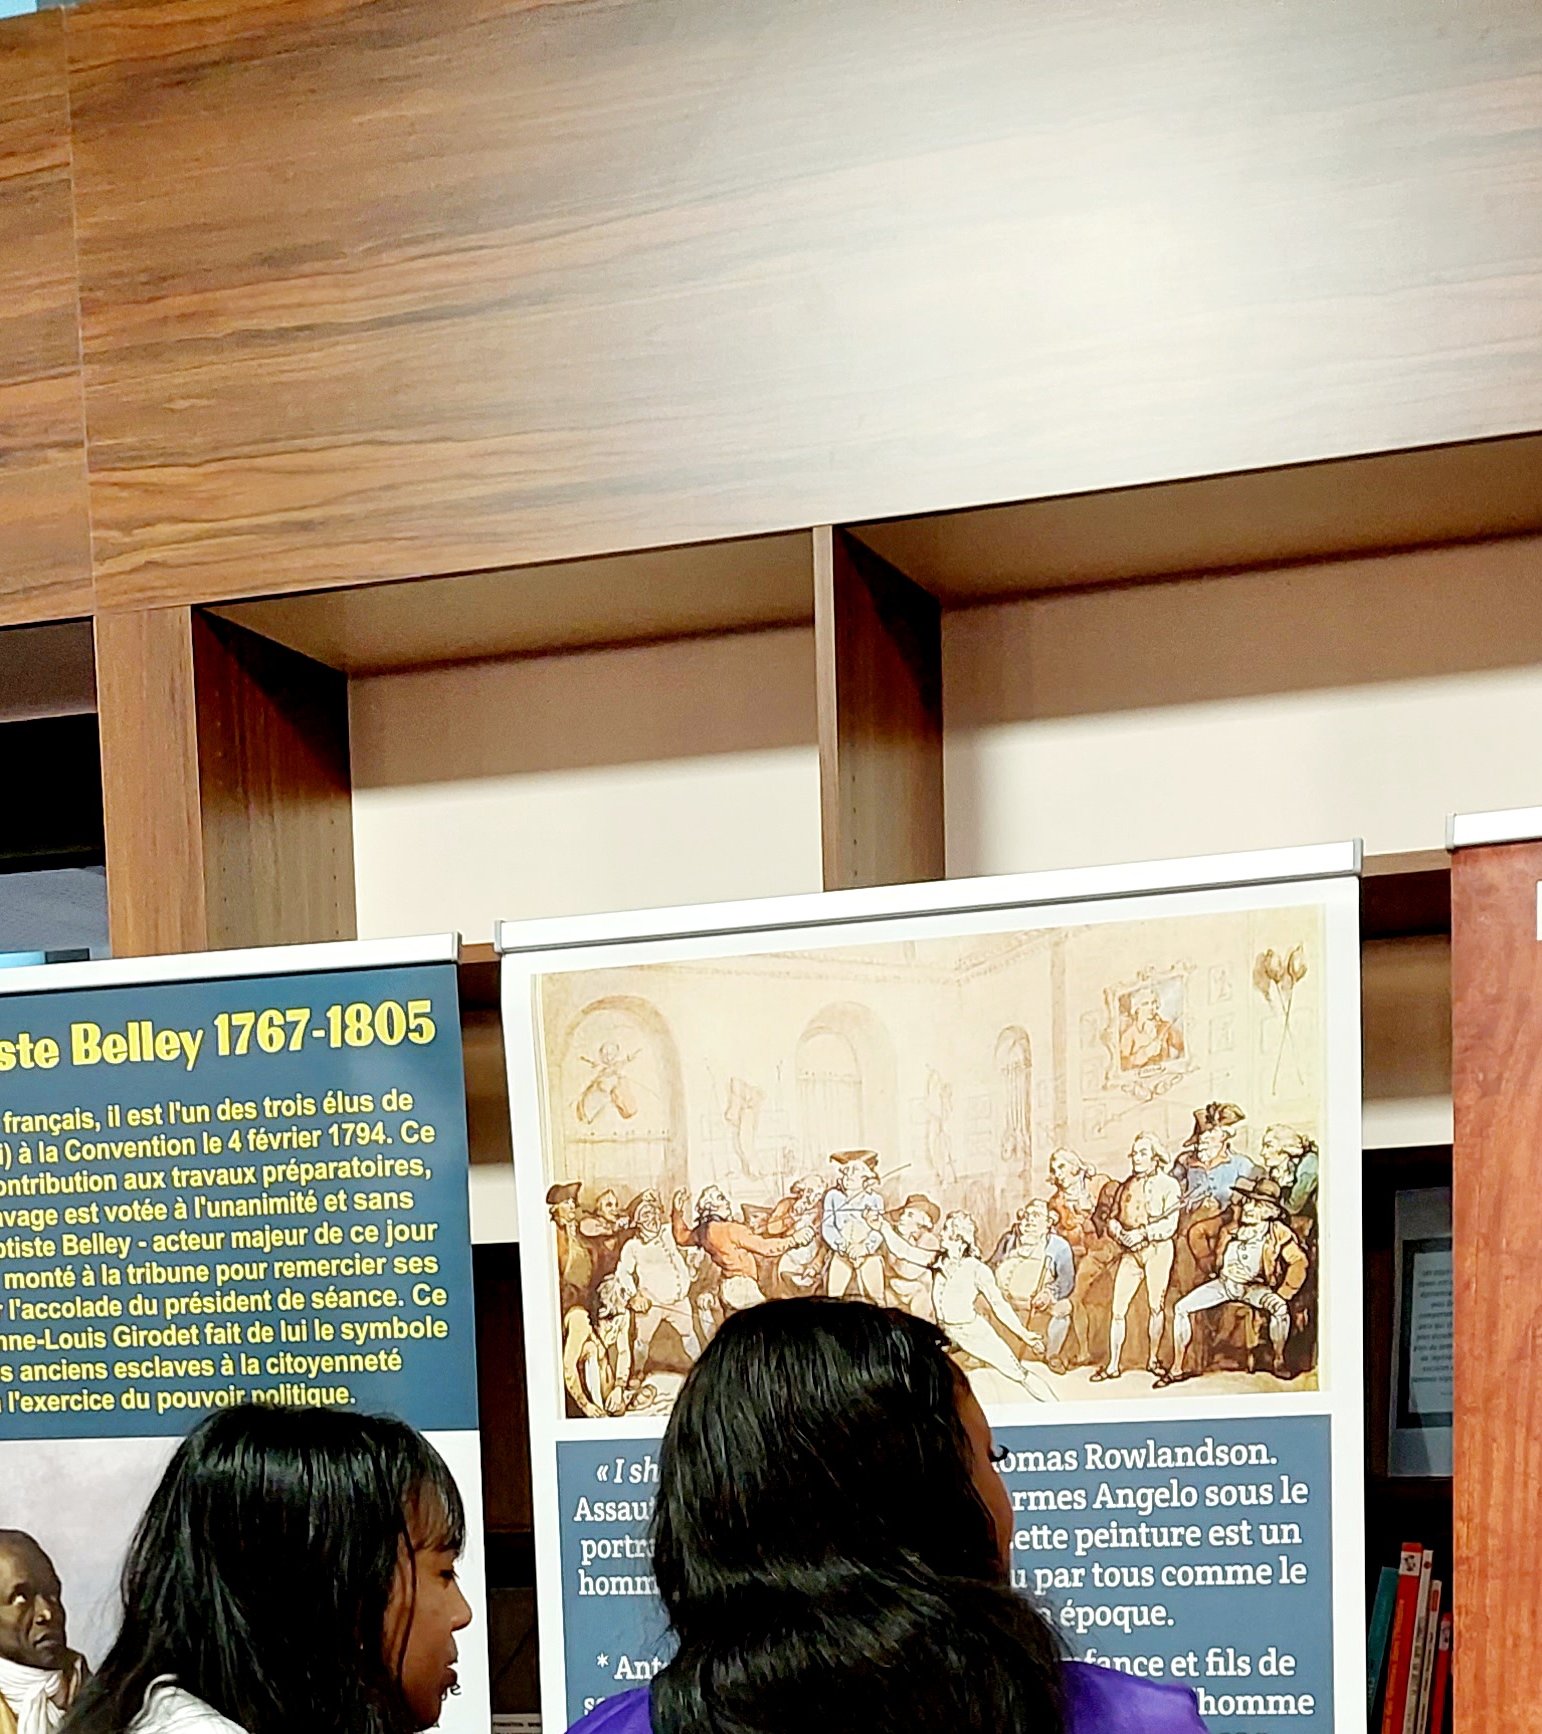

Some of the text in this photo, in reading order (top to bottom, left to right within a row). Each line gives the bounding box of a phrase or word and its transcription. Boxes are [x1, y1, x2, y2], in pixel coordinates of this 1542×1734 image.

[71, 1022, 203, 1070] Belley
[214, 1000, 435, 1055] 1767-1805
[3, 1108, 100, 1135] français,
[108, 1105, 120, 1127] il
[128, 1104, 163, 1126] est
[169, 1102, 209, 1123] l'un
[217, 1098, 256, 1120] des
[263, 1094, 316, 1117] trois
[323, 1091, 374, 1113] élus
[382, 1088, 413, 1111] de
[1085, 1438, 1277, 1469] Rowlandson.
[1093, 1476, 1308, 1515] Angelo sous le
[1075, 1520, 1302, 1555] peinture est un
[1061, 1599, 1174, 1633] époque.
[1171, 1648, 1295, 1676] et fils de
